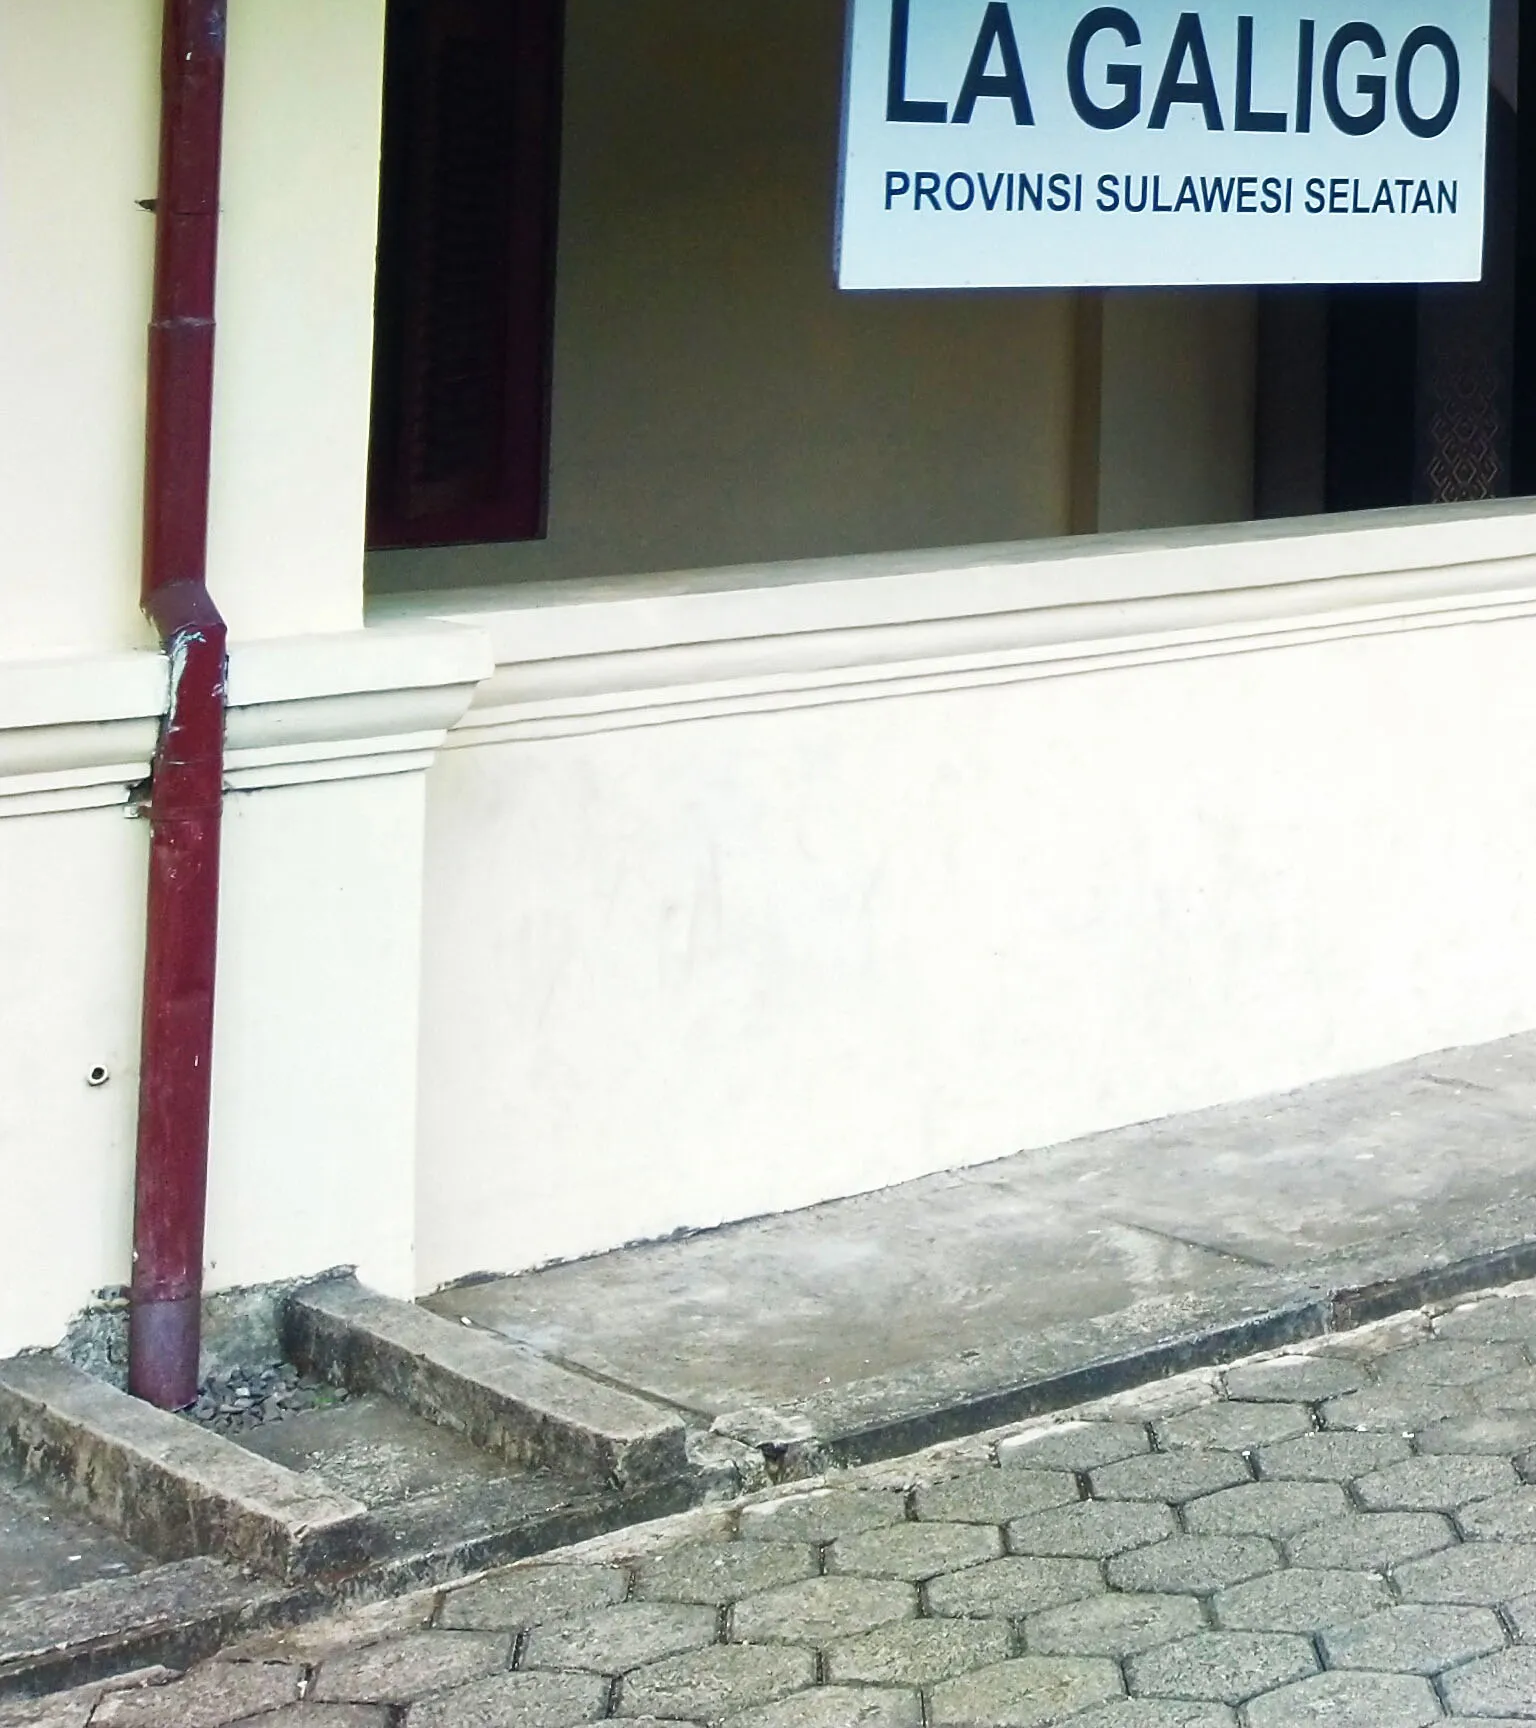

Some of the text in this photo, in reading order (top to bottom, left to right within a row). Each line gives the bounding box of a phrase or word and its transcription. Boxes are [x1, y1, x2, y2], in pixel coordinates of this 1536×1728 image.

[1066, 6, 1460, 139] GALIGO
[884, 171, 1458, 215] PROVINSI SULAWESI SELATAN
